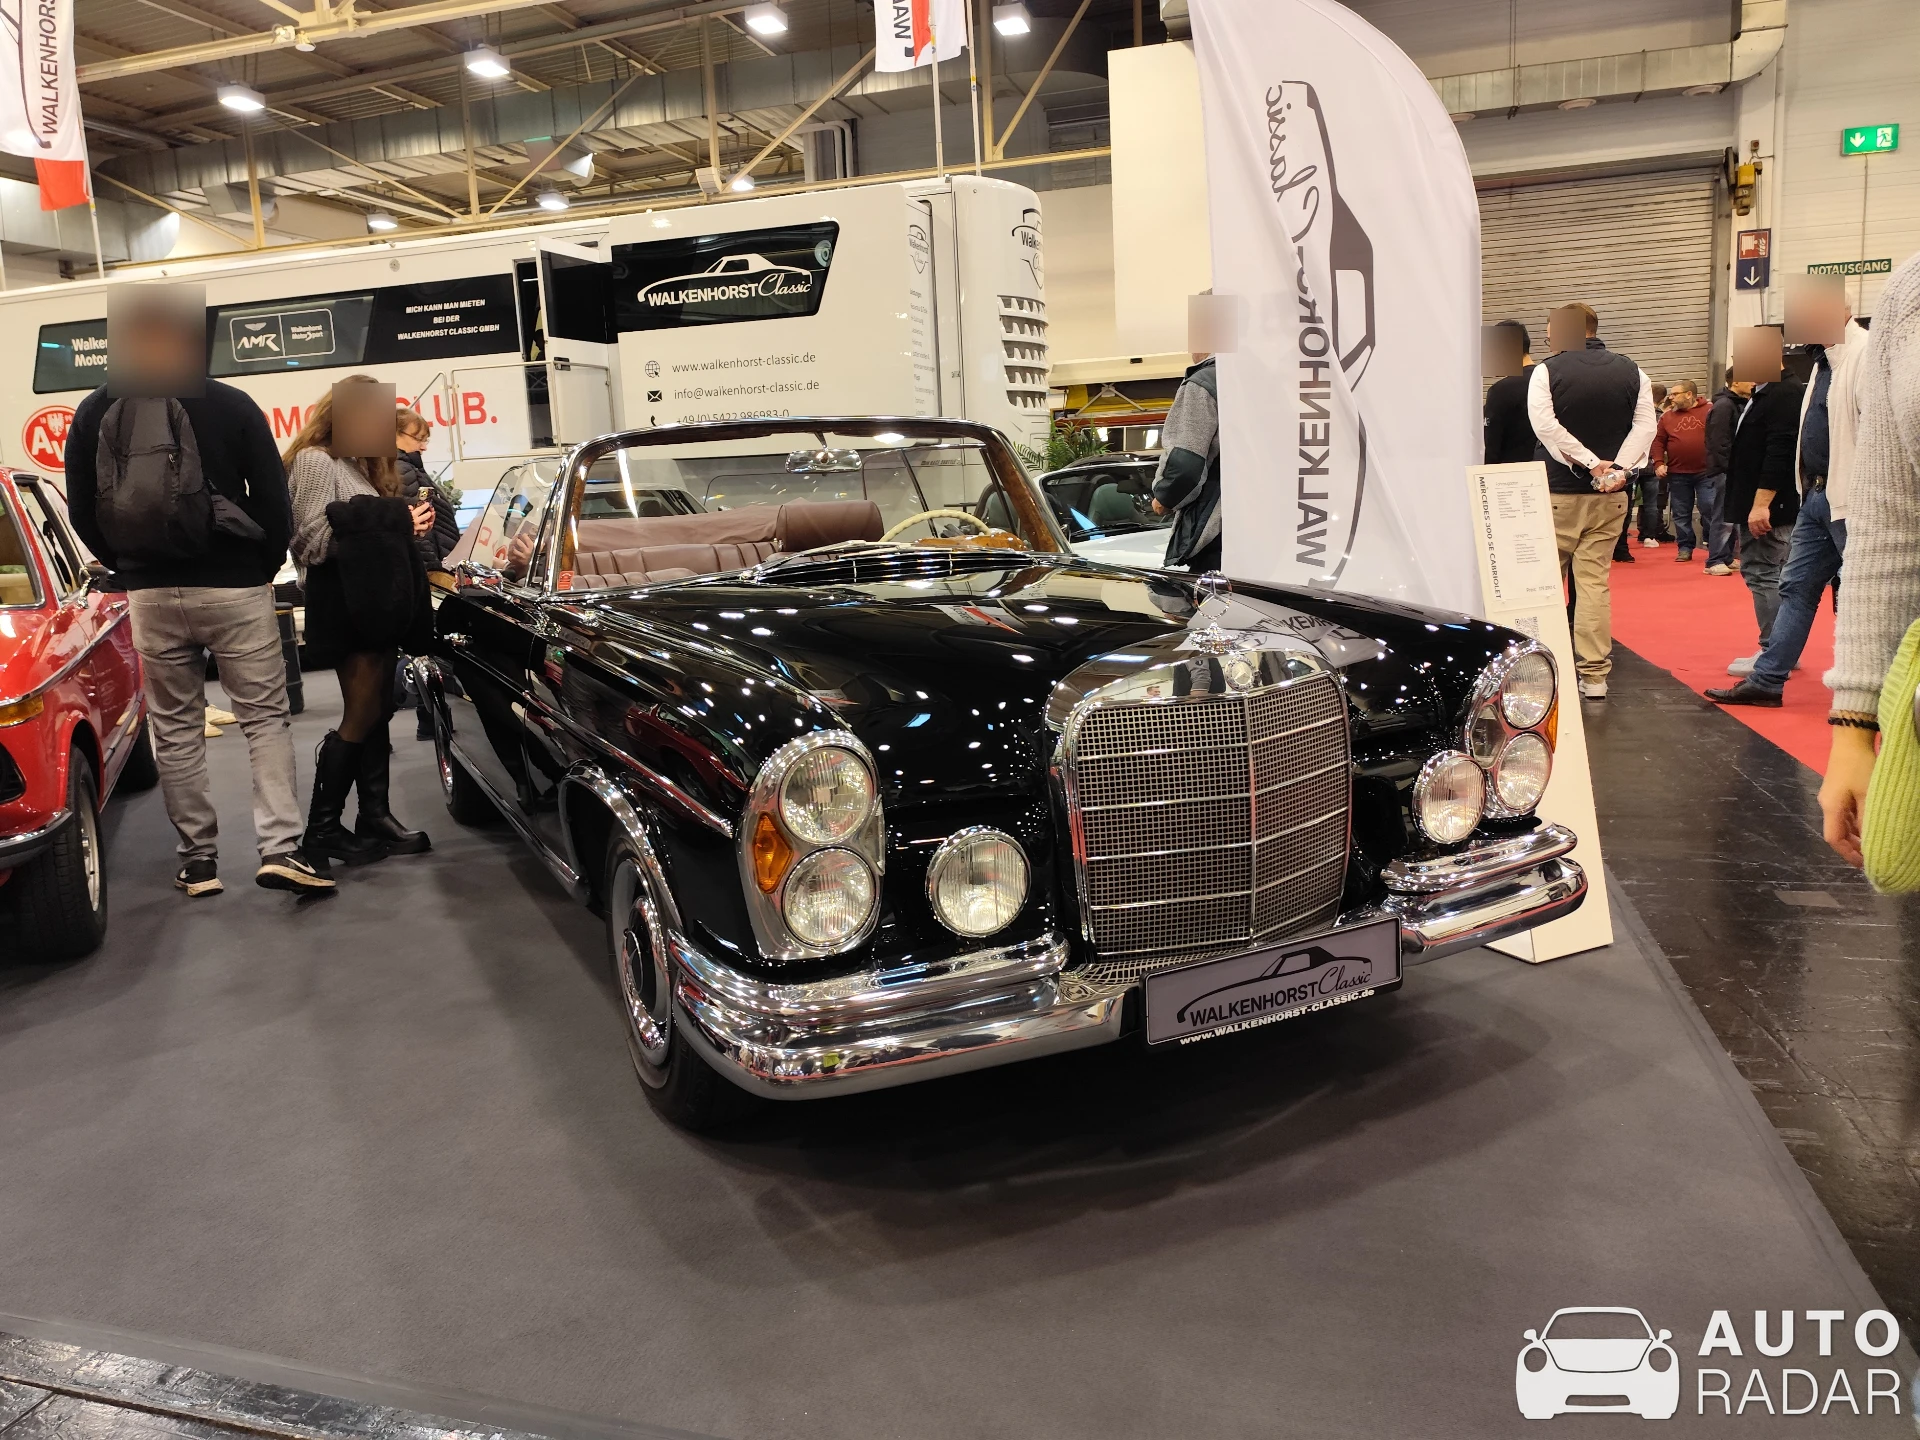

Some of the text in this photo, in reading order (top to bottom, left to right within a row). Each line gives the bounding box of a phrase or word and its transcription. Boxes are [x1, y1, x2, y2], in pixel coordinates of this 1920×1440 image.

[1809, 261, 1889, 274] NOTAUSGANG
[648, 272, 811, 307] WALKENHORST Classic
[405, 299, 486, 314] MICH KANN MAN MIETEN
[433, 314, 460, 324] BEI DER
[397, 323, 500, 340] WALKENHORST CLASSIC GMBH
[672, 352, 816, 373] www.walkenhorst-classic.de
[674, 380, 820, 400] info@walkenhorst-classic.de
[1478, 476, 1502, 598] MERCEDES 300 SE CABRIOLET
[1190, 966, 1372, 1027] WALKENHORST Classic
[1179, 988, 1375, 1045] www.WALKENHORST-CLASSIC.de
